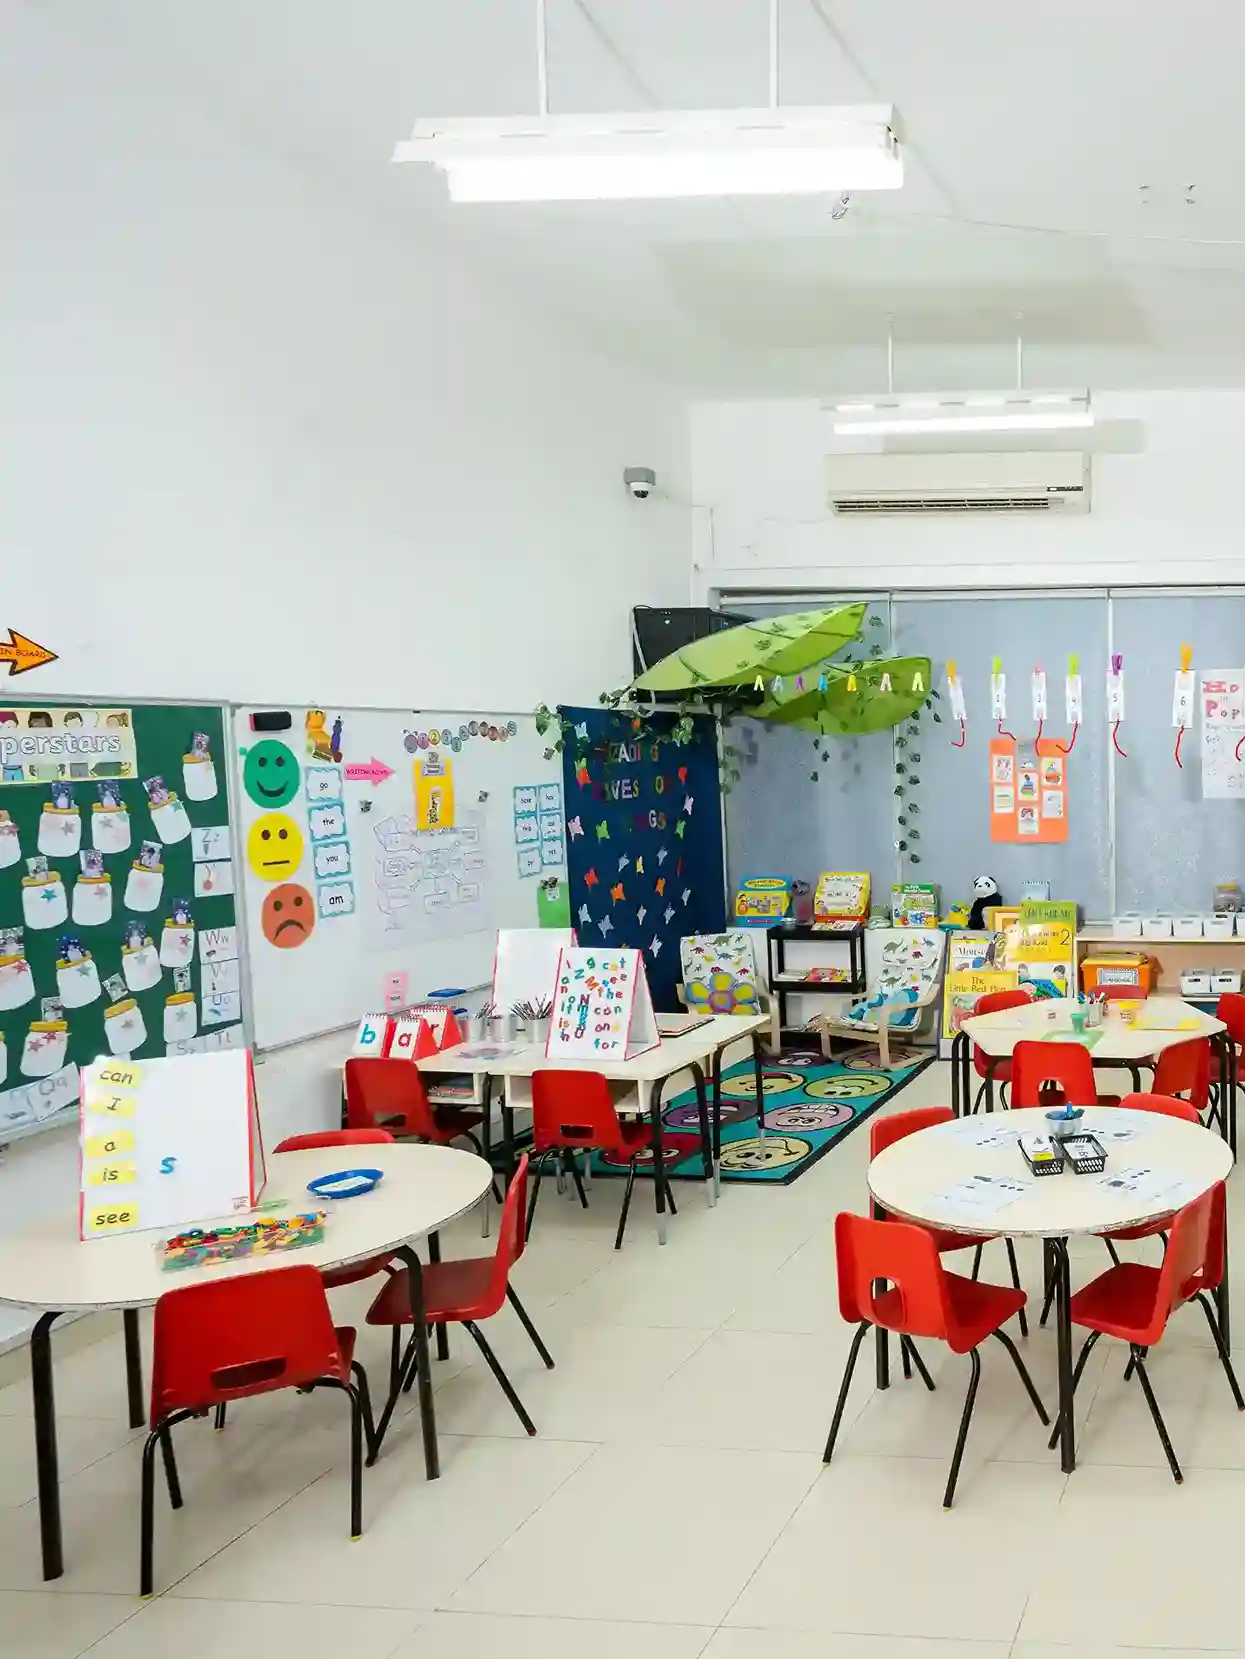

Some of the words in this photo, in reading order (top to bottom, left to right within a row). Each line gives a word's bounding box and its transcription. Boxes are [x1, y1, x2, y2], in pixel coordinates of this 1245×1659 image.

[321, 817, 335, 826] the
[325, 854, 339, 865] you
[328, 894, 344, 905] am
[1059, 927, 1071, 946] 2
[971, 984, 987, 993] Red
[360, 1023, 377, 1045] b
[397, 1032, 413, 1048] a
[99, 1068, 133, 1085] can
[106, 1097, 122, 1111] I
[102, 1167, 119, 1183] is
[95, 1210, 131, 1227] see
